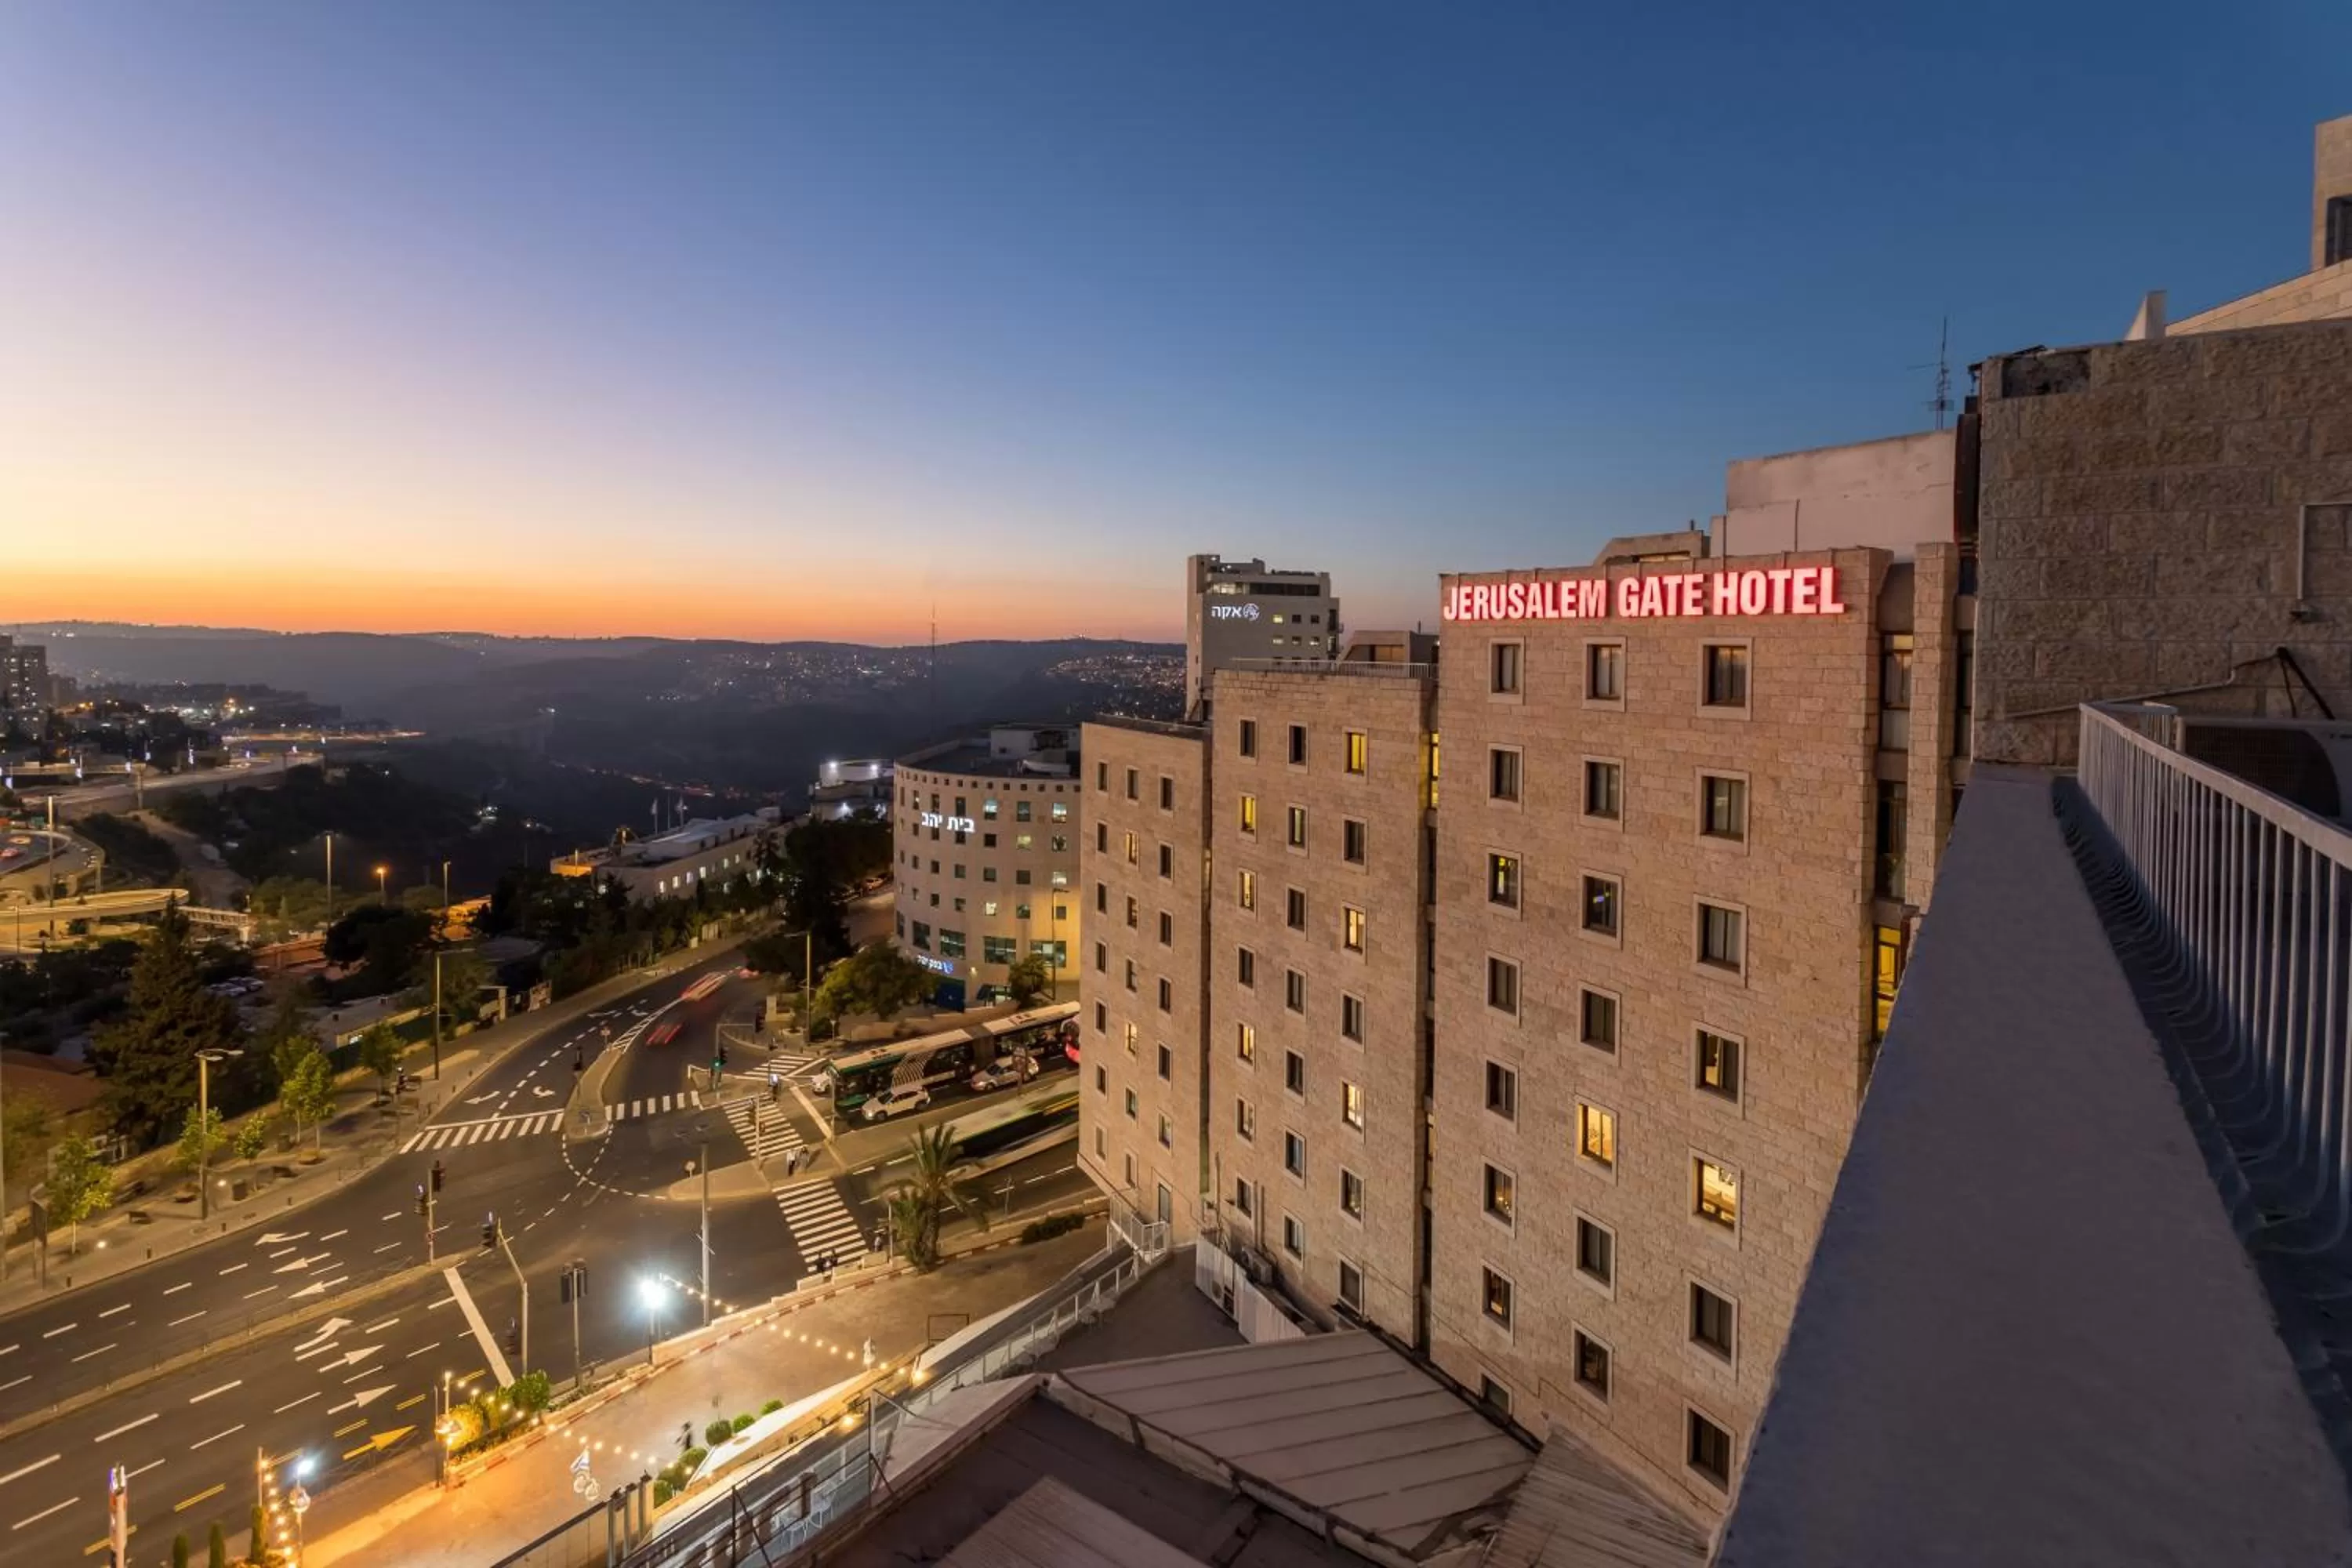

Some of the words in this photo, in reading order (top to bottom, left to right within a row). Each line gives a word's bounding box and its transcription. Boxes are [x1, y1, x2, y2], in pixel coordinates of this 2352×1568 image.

[1443, 579, 1607, 620] JERUSALEM
[1617, 573, 1704, 618] GATE
[1712, 566, 1845, 616] HOTEL
[1210, 605, 1243, 620] אקה
[921, 811, 943, 828] יהב
[946, 816, 975, 833] בית
